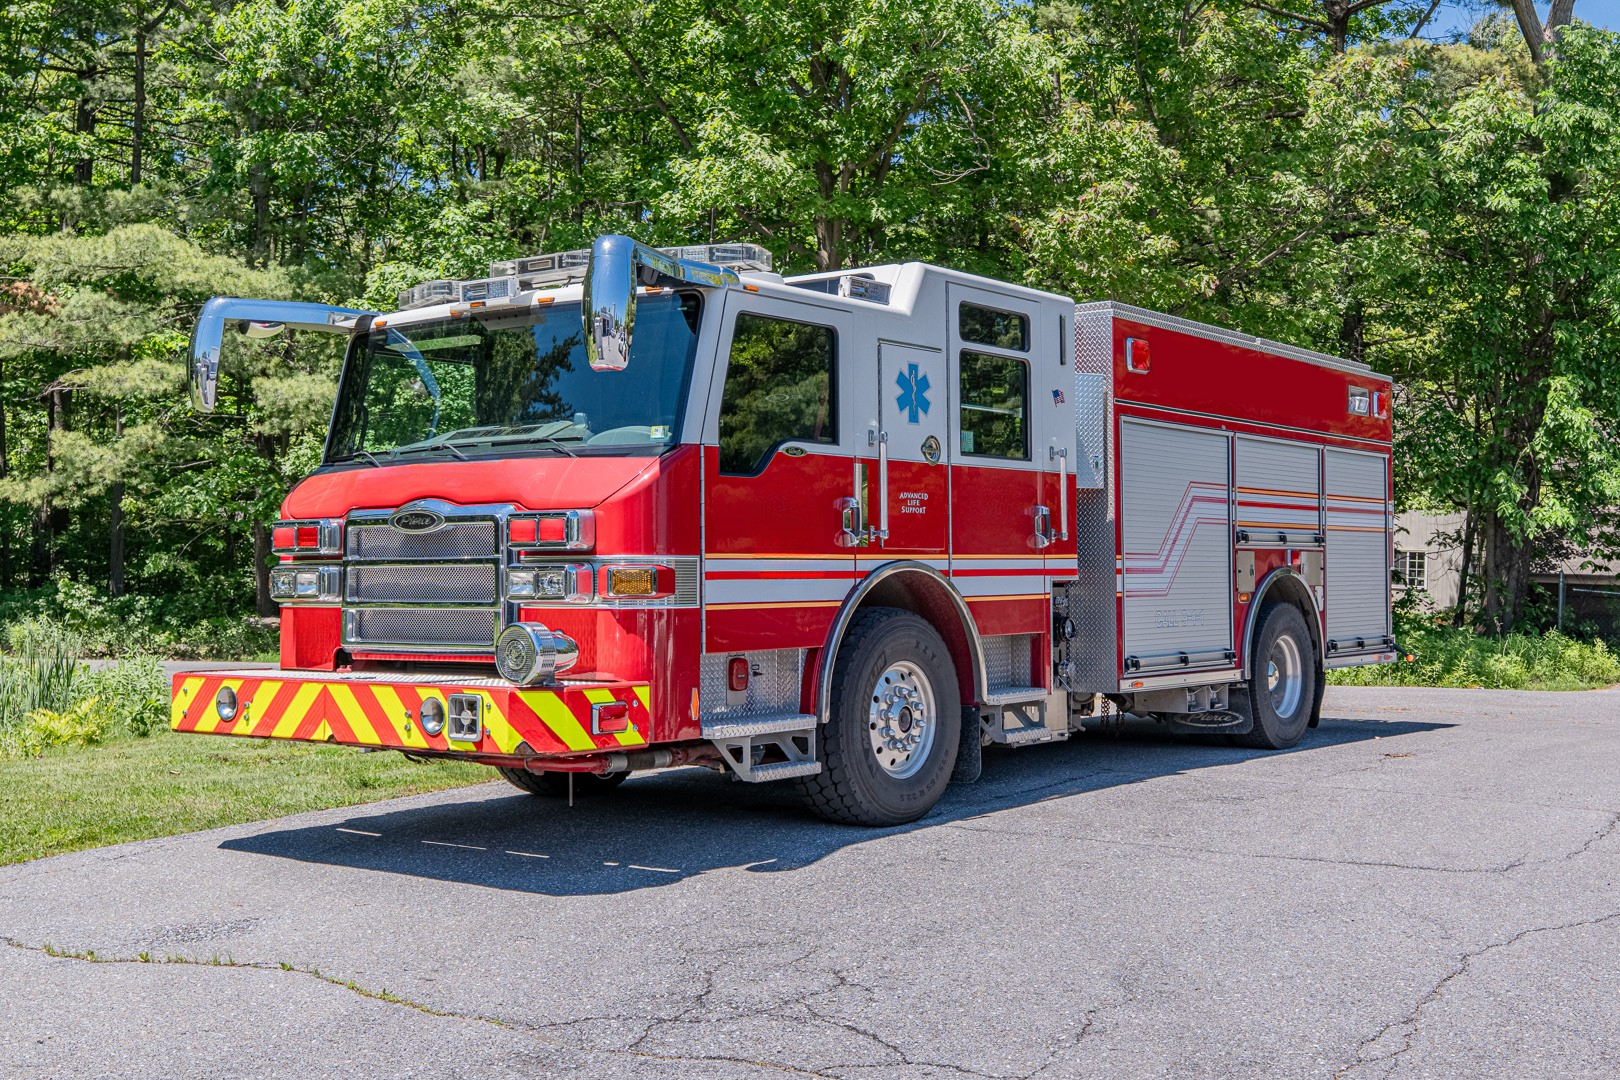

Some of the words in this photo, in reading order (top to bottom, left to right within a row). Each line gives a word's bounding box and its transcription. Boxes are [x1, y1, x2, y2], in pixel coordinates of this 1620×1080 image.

[899, 492, 928, 500] ADVANCED
[901, 505, 926, 514] SUPPORT
[1155, 610, 1179, 628] CALL
[1182, 609, 1204, 626] 9-1-1
[861, 651, 887, 750] MICHELIN
[1186, 711, 1233, 723] Pierce
